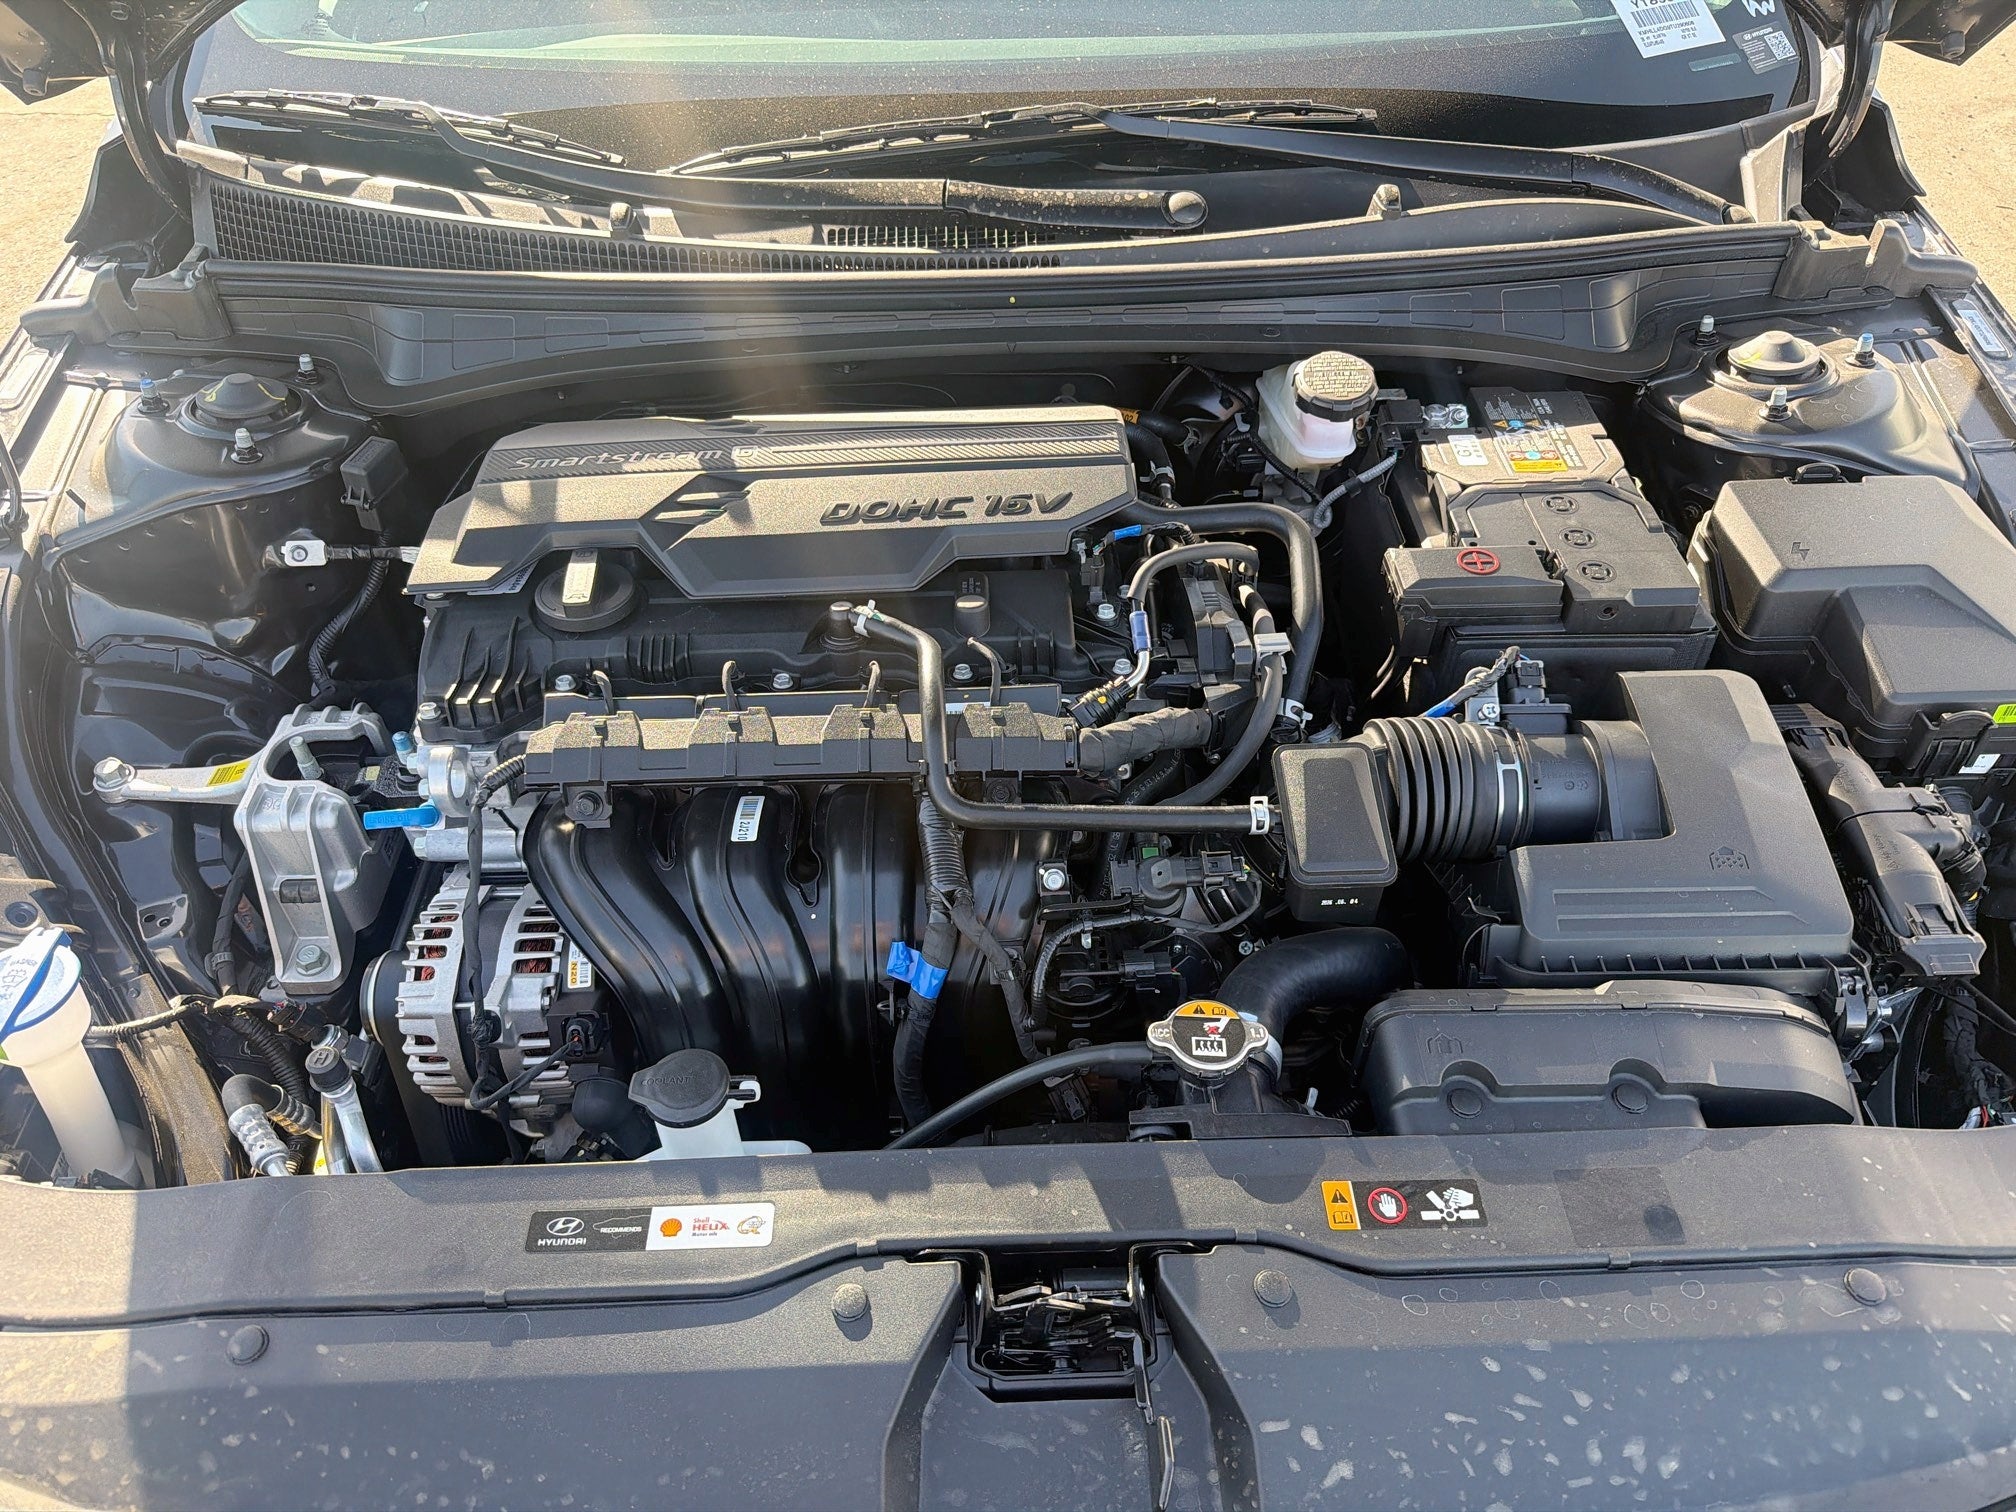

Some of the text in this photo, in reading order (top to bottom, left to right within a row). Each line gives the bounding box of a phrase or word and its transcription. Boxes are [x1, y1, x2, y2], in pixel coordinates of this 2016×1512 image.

[508, 450, 722, 470] Smartstream
[819, 491, 1073, 525] DOHC 16V
[641, 1075, 692, 1087] COOLANT
[600, 1226, 642, 1234] RECOMMENDS
[692, 1222, 729, 1232] HELIX
[537, 1237, 587, 1247] HYUNDAI
